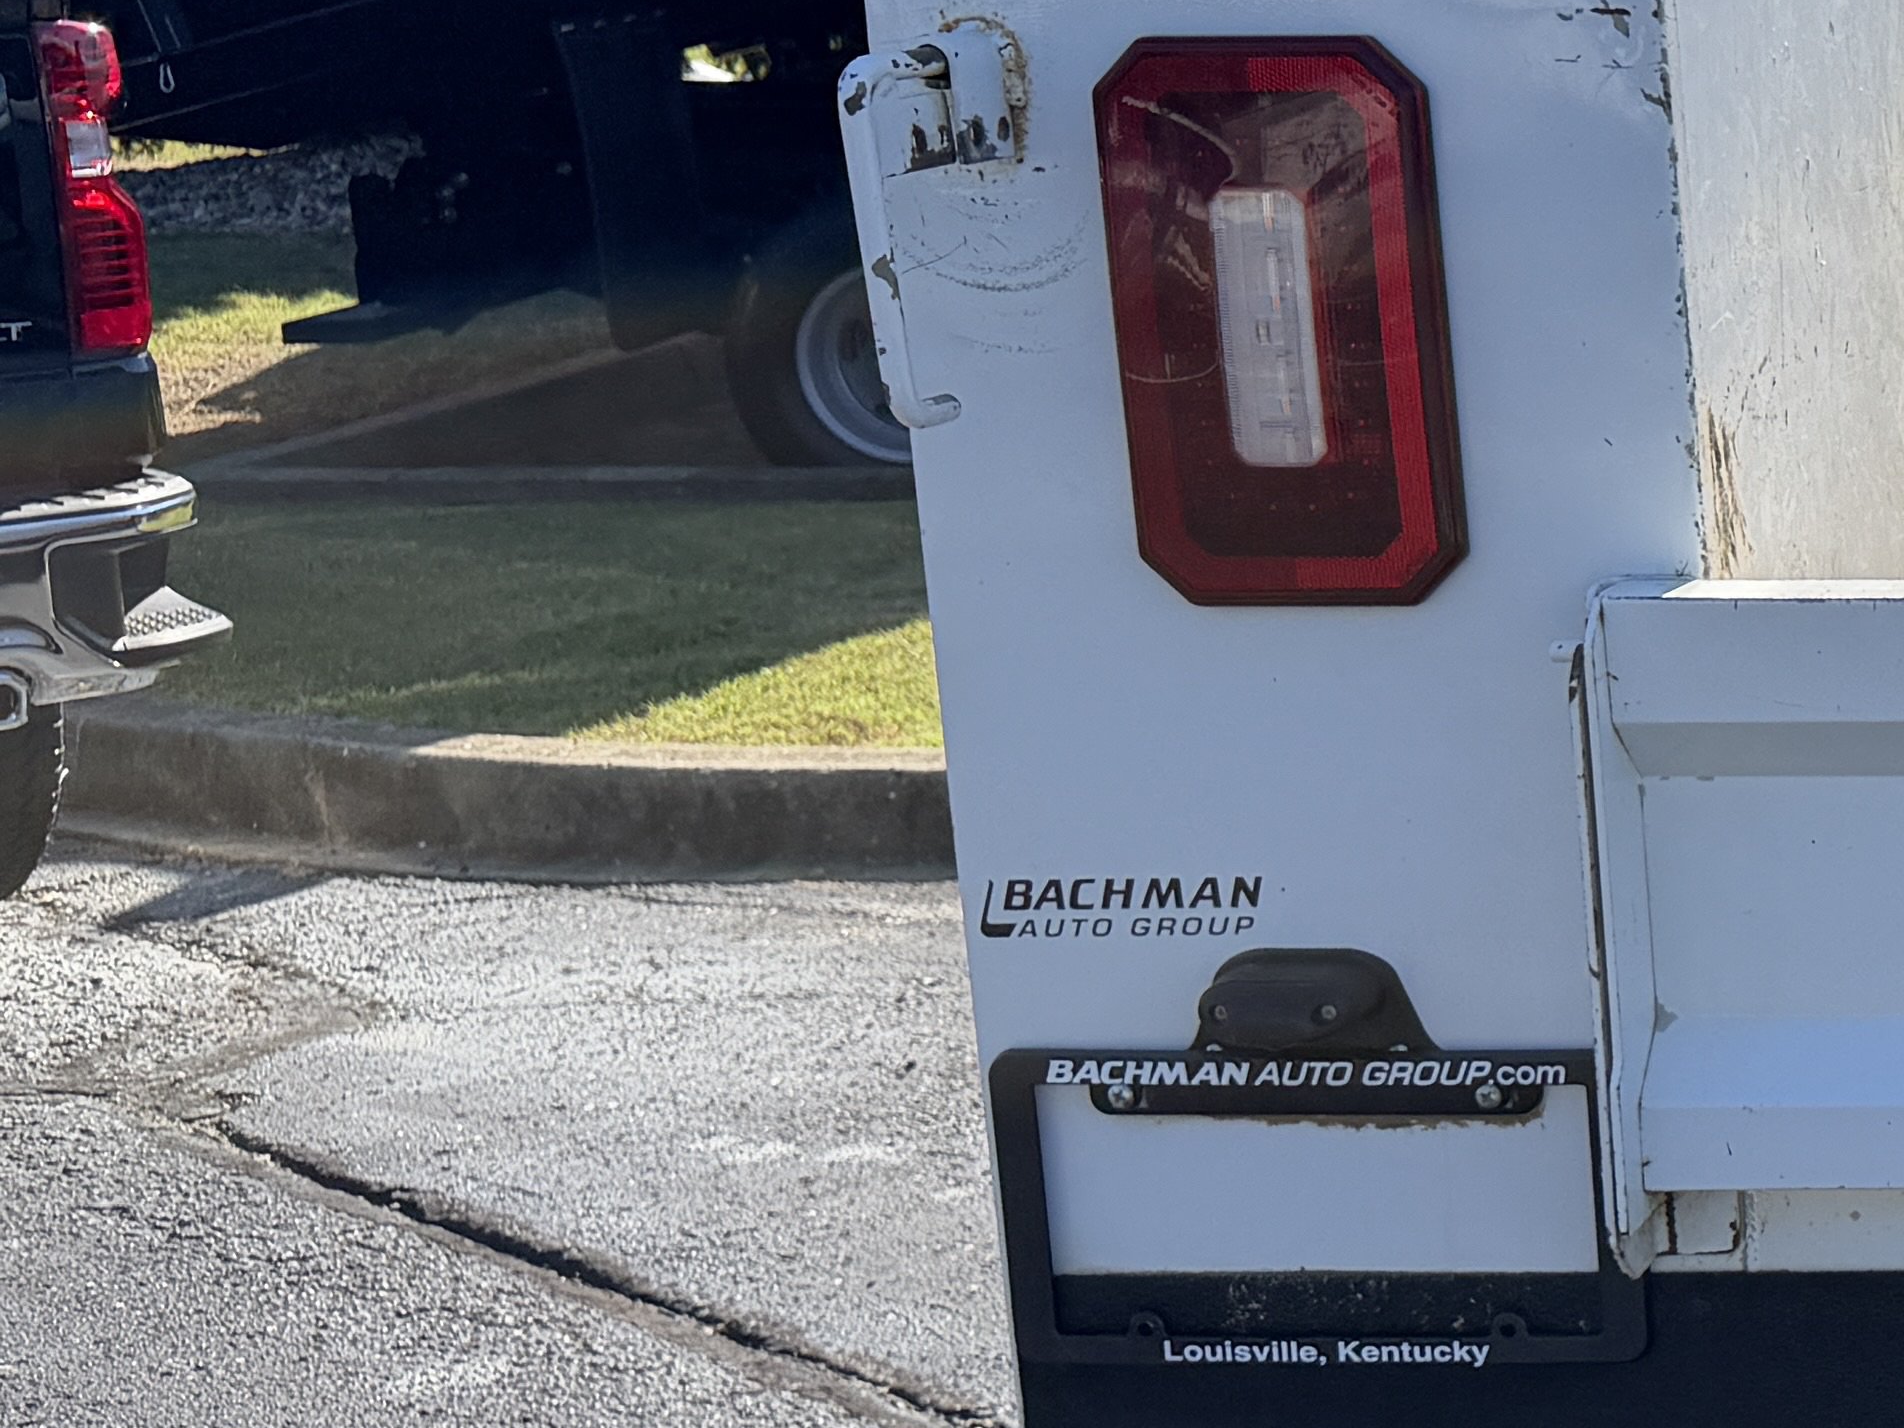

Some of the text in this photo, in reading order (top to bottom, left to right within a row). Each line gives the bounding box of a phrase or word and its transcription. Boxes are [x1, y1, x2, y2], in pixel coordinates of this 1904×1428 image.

[1003, 876, 1263, 910] BACHMAN
[1018, 917, 1256, 938] AUTO GROUP
[1046, 1060, 1566, 1086] BACHMAN AUTO GROUP.com
[1163, 1339, 1490, 1367] Louisville, Kentucky
